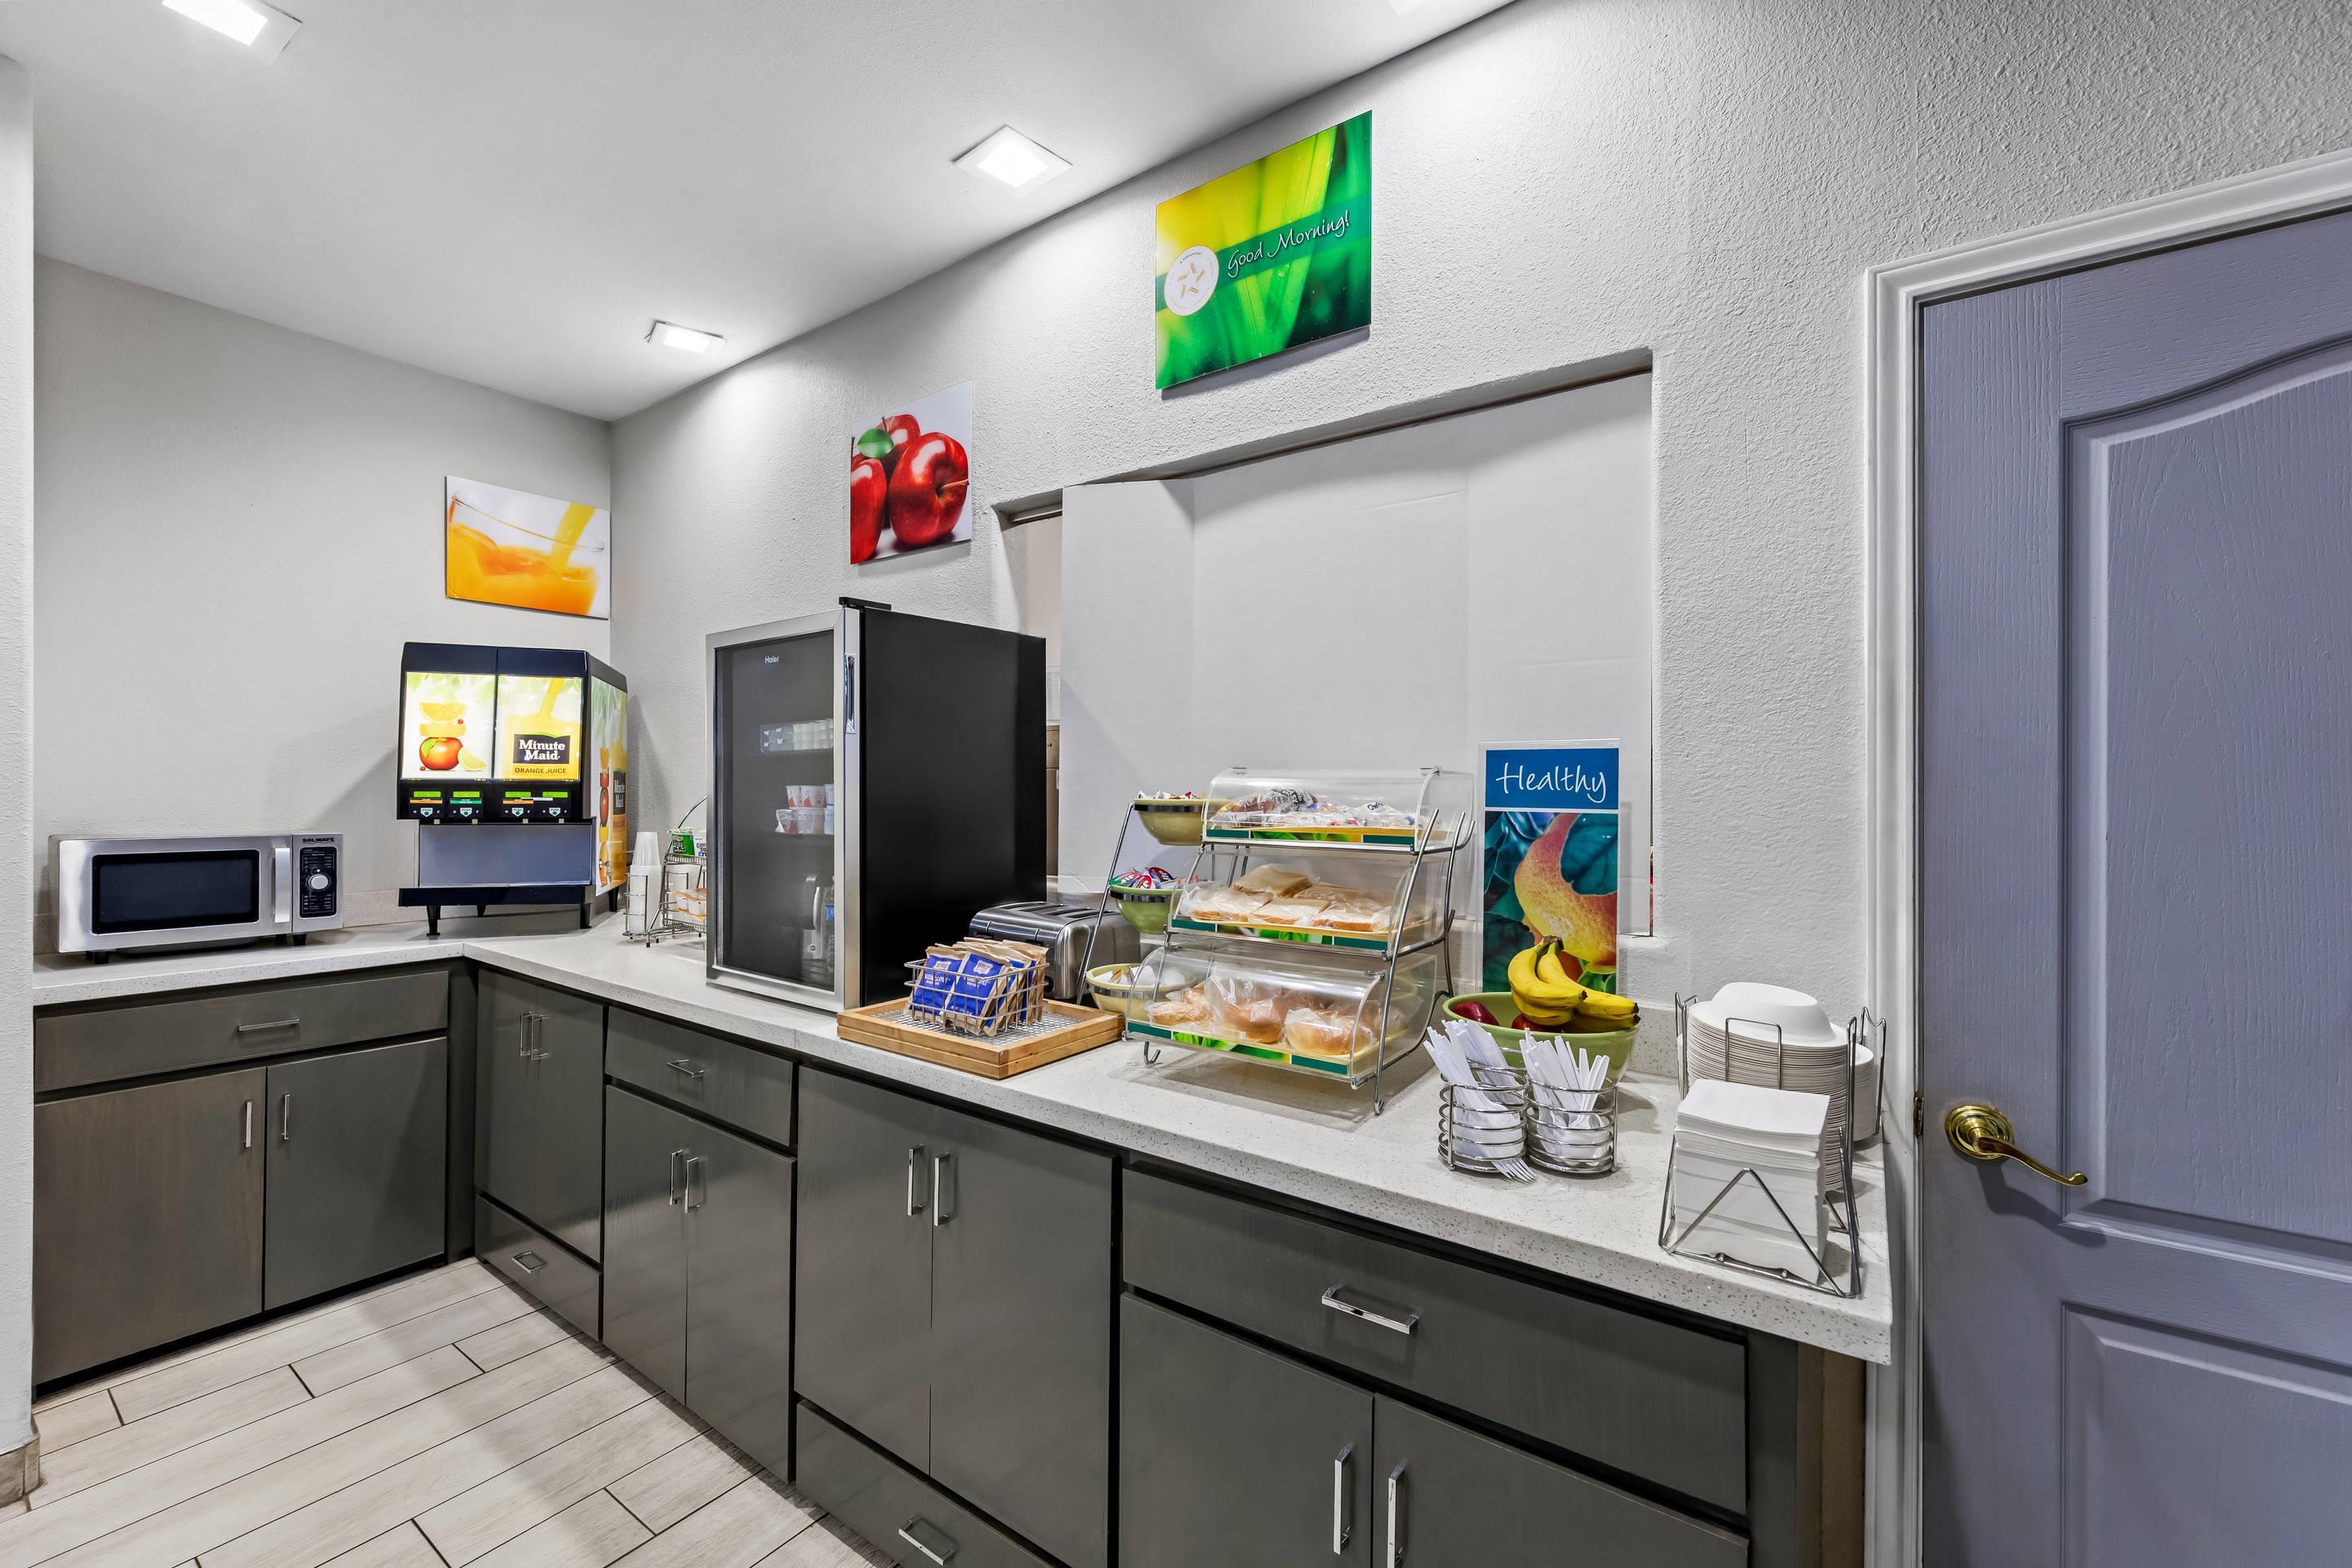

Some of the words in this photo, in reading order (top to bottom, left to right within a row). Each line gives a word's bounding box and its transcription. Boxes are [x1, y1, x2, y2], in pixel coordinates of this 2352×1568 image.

[1227, 241, 1263, 278] Good
[1267, 209, 1350, 258] Morning!
[764, 655, 780, 663] Haier
[519, 739, 566, 751] Minute
[524, 749, 559, 760] Maid
[1496, 762, 1606, 804] Healthy
